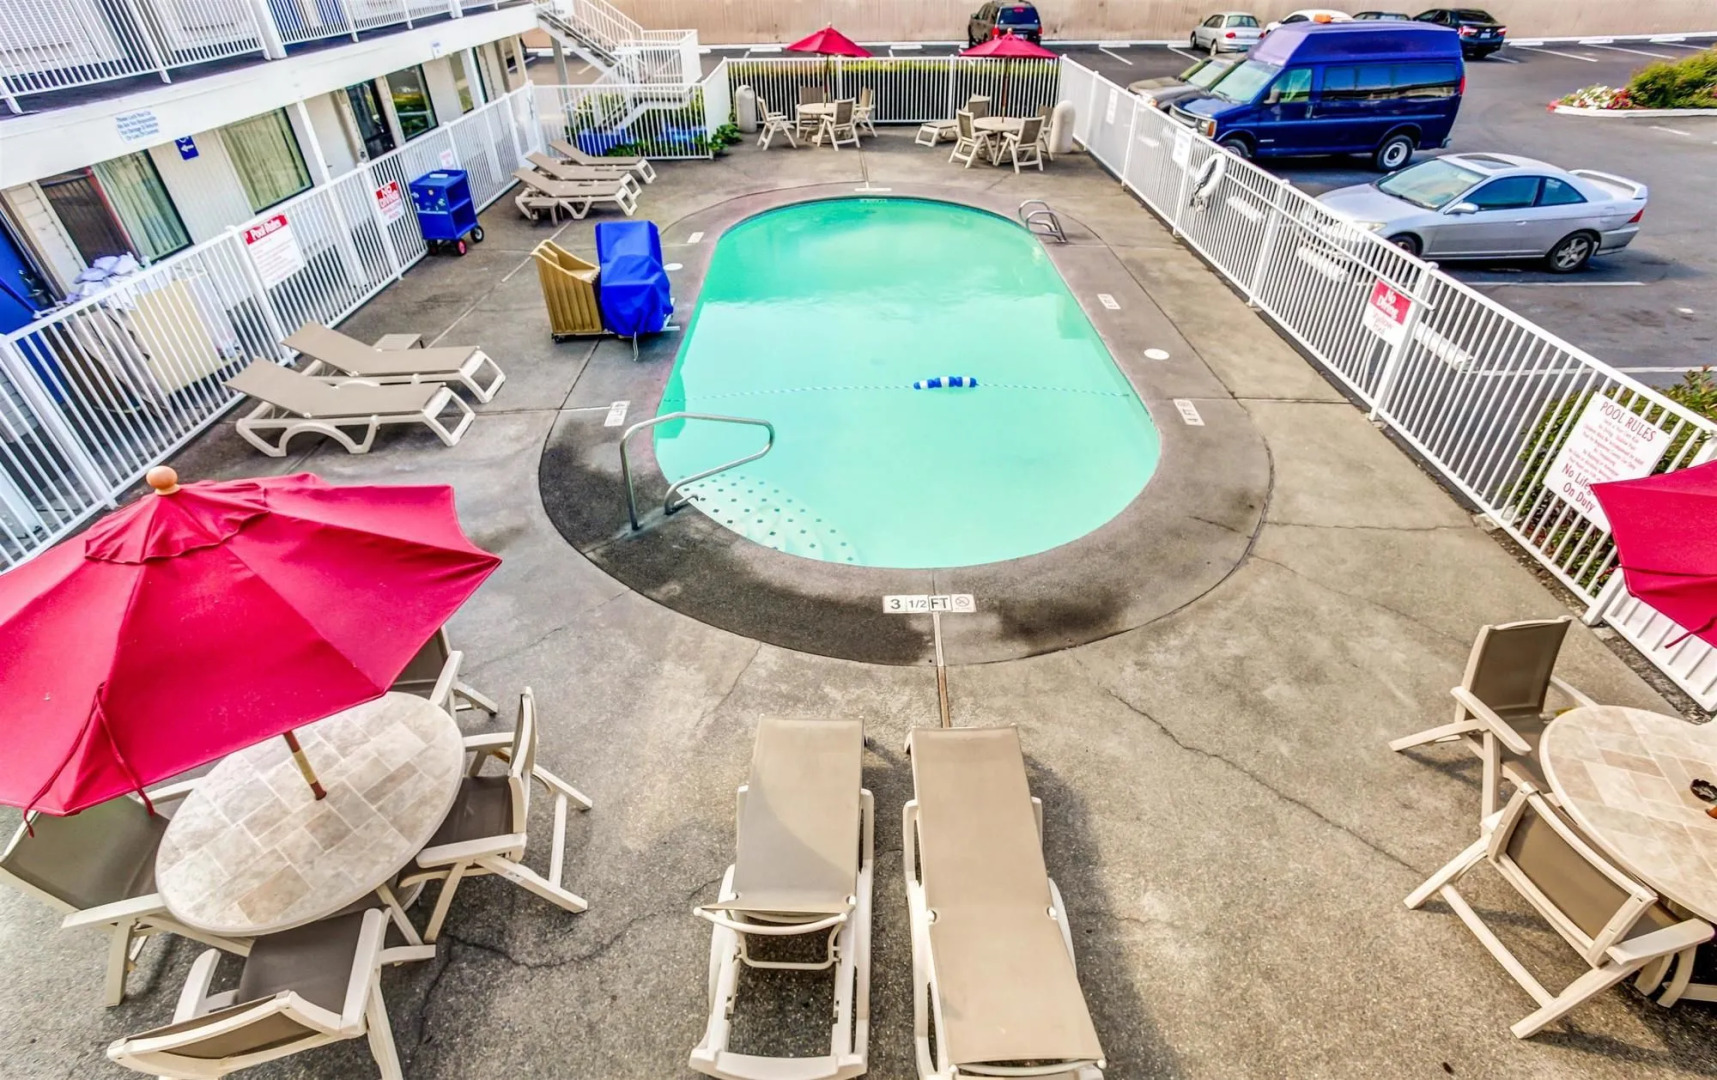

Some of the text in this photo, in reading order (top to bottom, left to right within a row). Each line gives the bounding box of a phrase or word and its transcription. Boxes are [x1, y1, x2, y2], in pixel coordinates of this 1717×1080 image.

[379, 184, 394, 199] NO
[249, 217, 283, 241] Pool Rules
[1599, 400, 1657, 442] POOL RULES
[1561, 462, 1575, 478] No
[1562, 482, 1597, 514] On Duty
[890, 597, 948, 610] 3 1/2 FT
